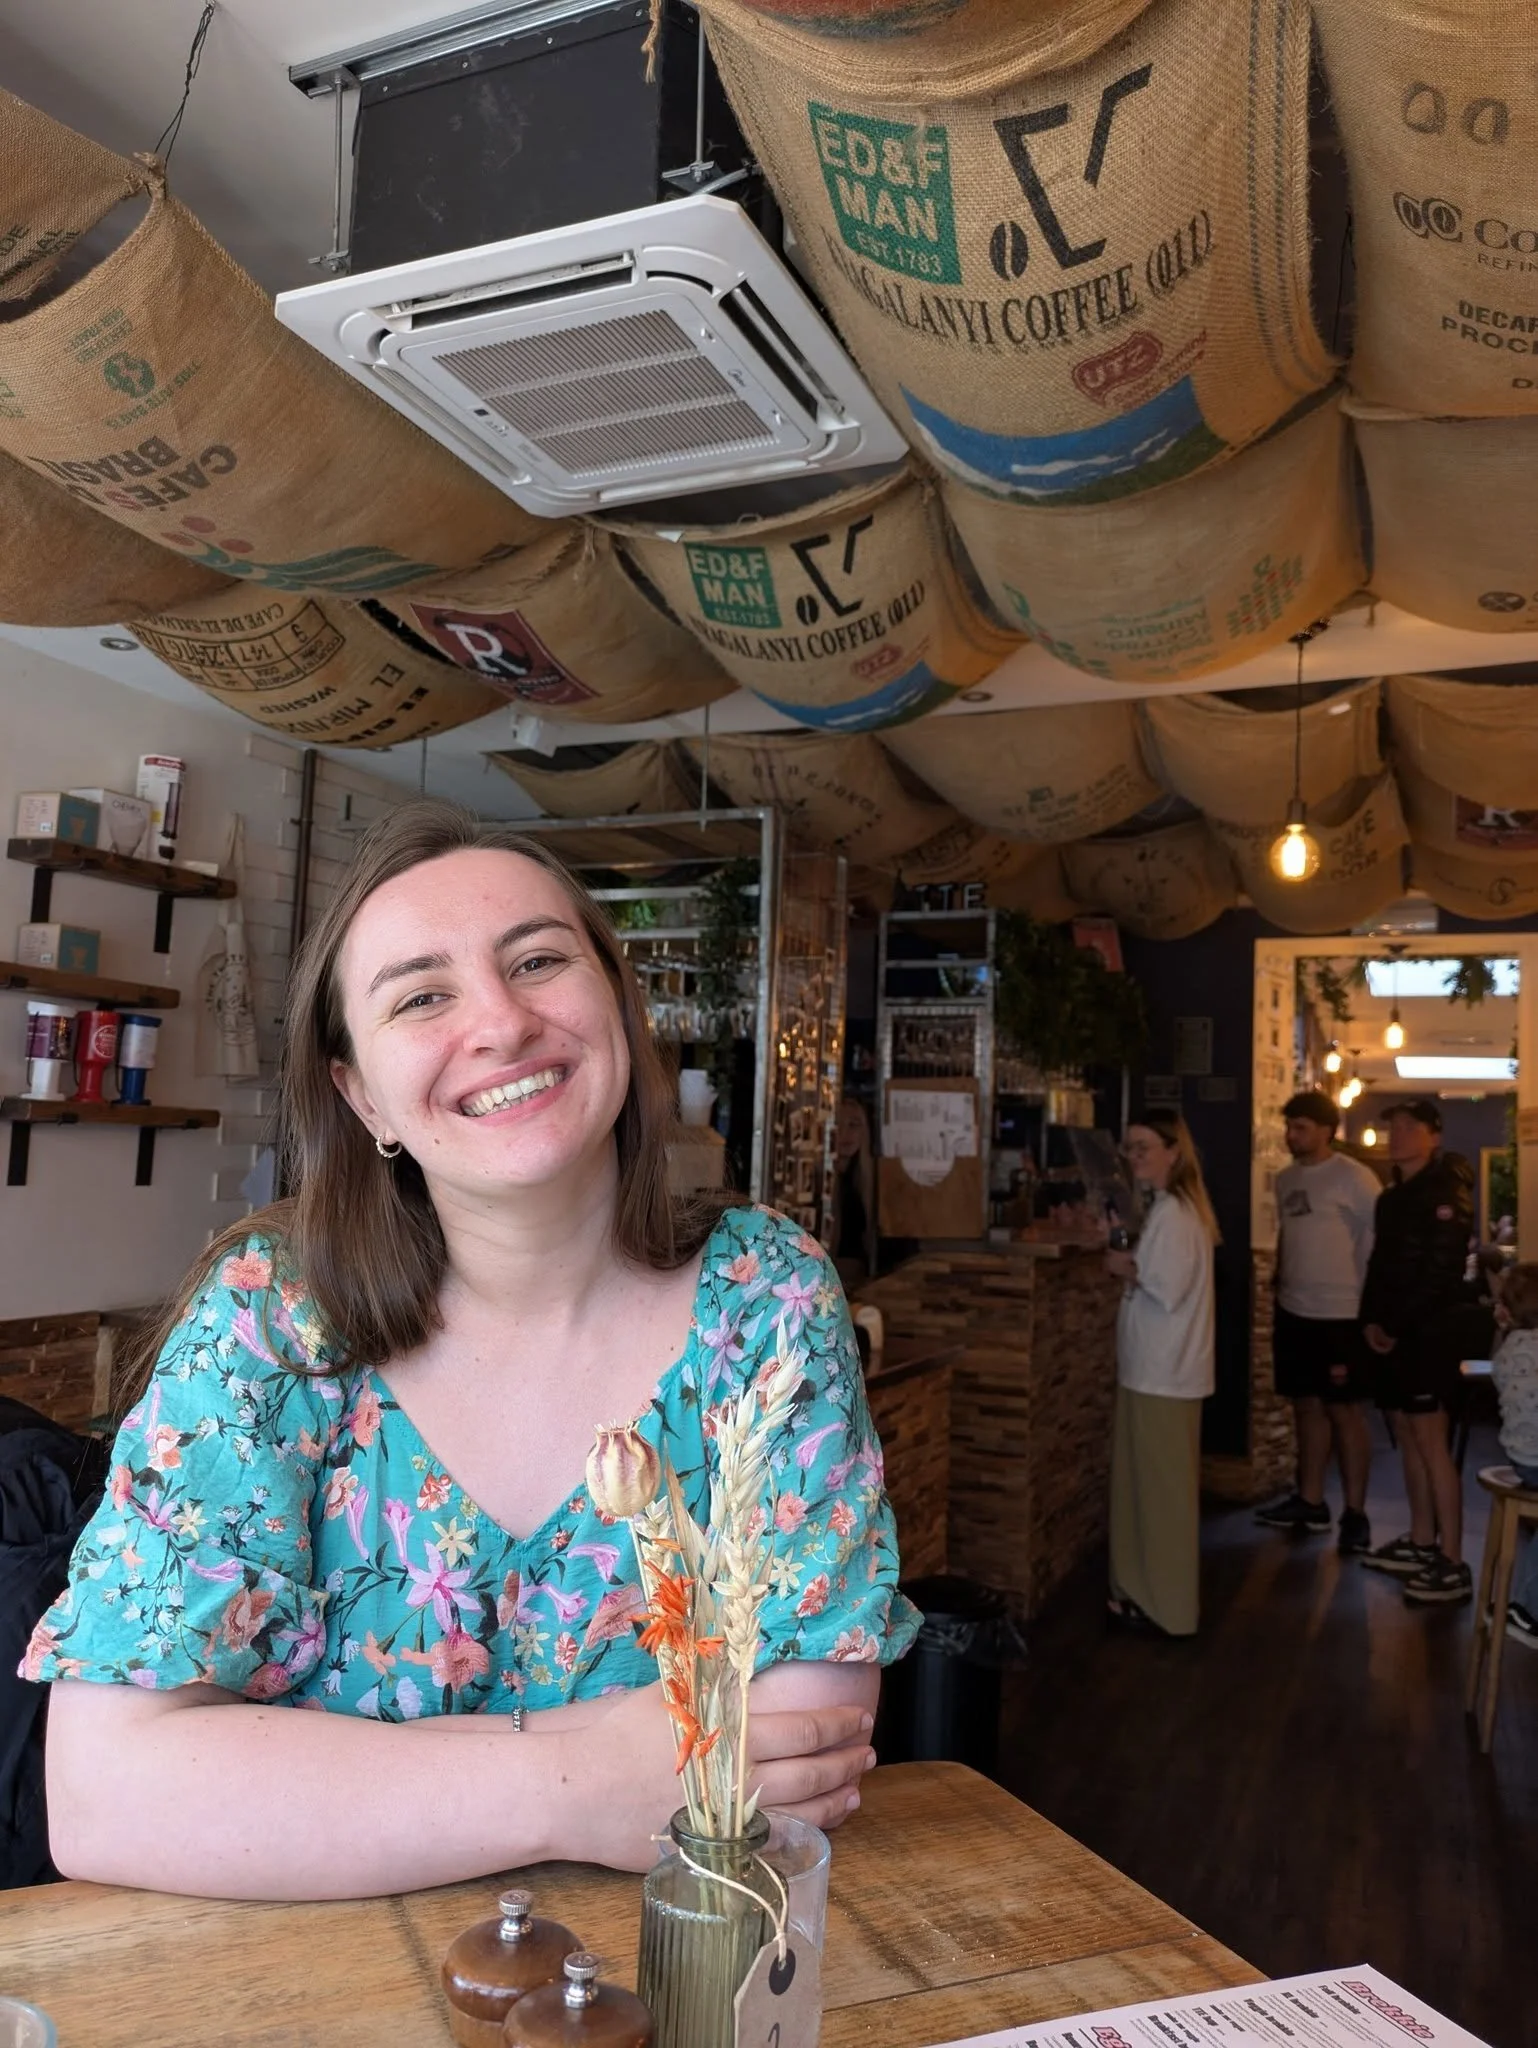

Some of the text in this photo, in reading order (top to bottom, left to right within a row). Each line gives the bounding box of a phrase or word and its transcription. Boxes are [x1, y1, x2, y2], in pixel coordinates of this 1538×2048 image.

[817, 119, 944, 189] ED&F
[835, 174, 938, 243] MAN
[895, 245, 943, 277] 1783
[1002, 262, 1140, 344] COFFEE
[1146, 209, 1211, 299] (011)
[687, 549, 765, 581] ED&F
[701, 578, 766, 608] MAN
[202, 619, 222, 634] EL
[222, 617, 244, 634] DE
[806, 611, 887, 660] COFFEE
[370, 662, 406, 688] EL
[259, 685, 337, 715] WASHED
[1341, 1980, 1435, 2039] Brekkie
